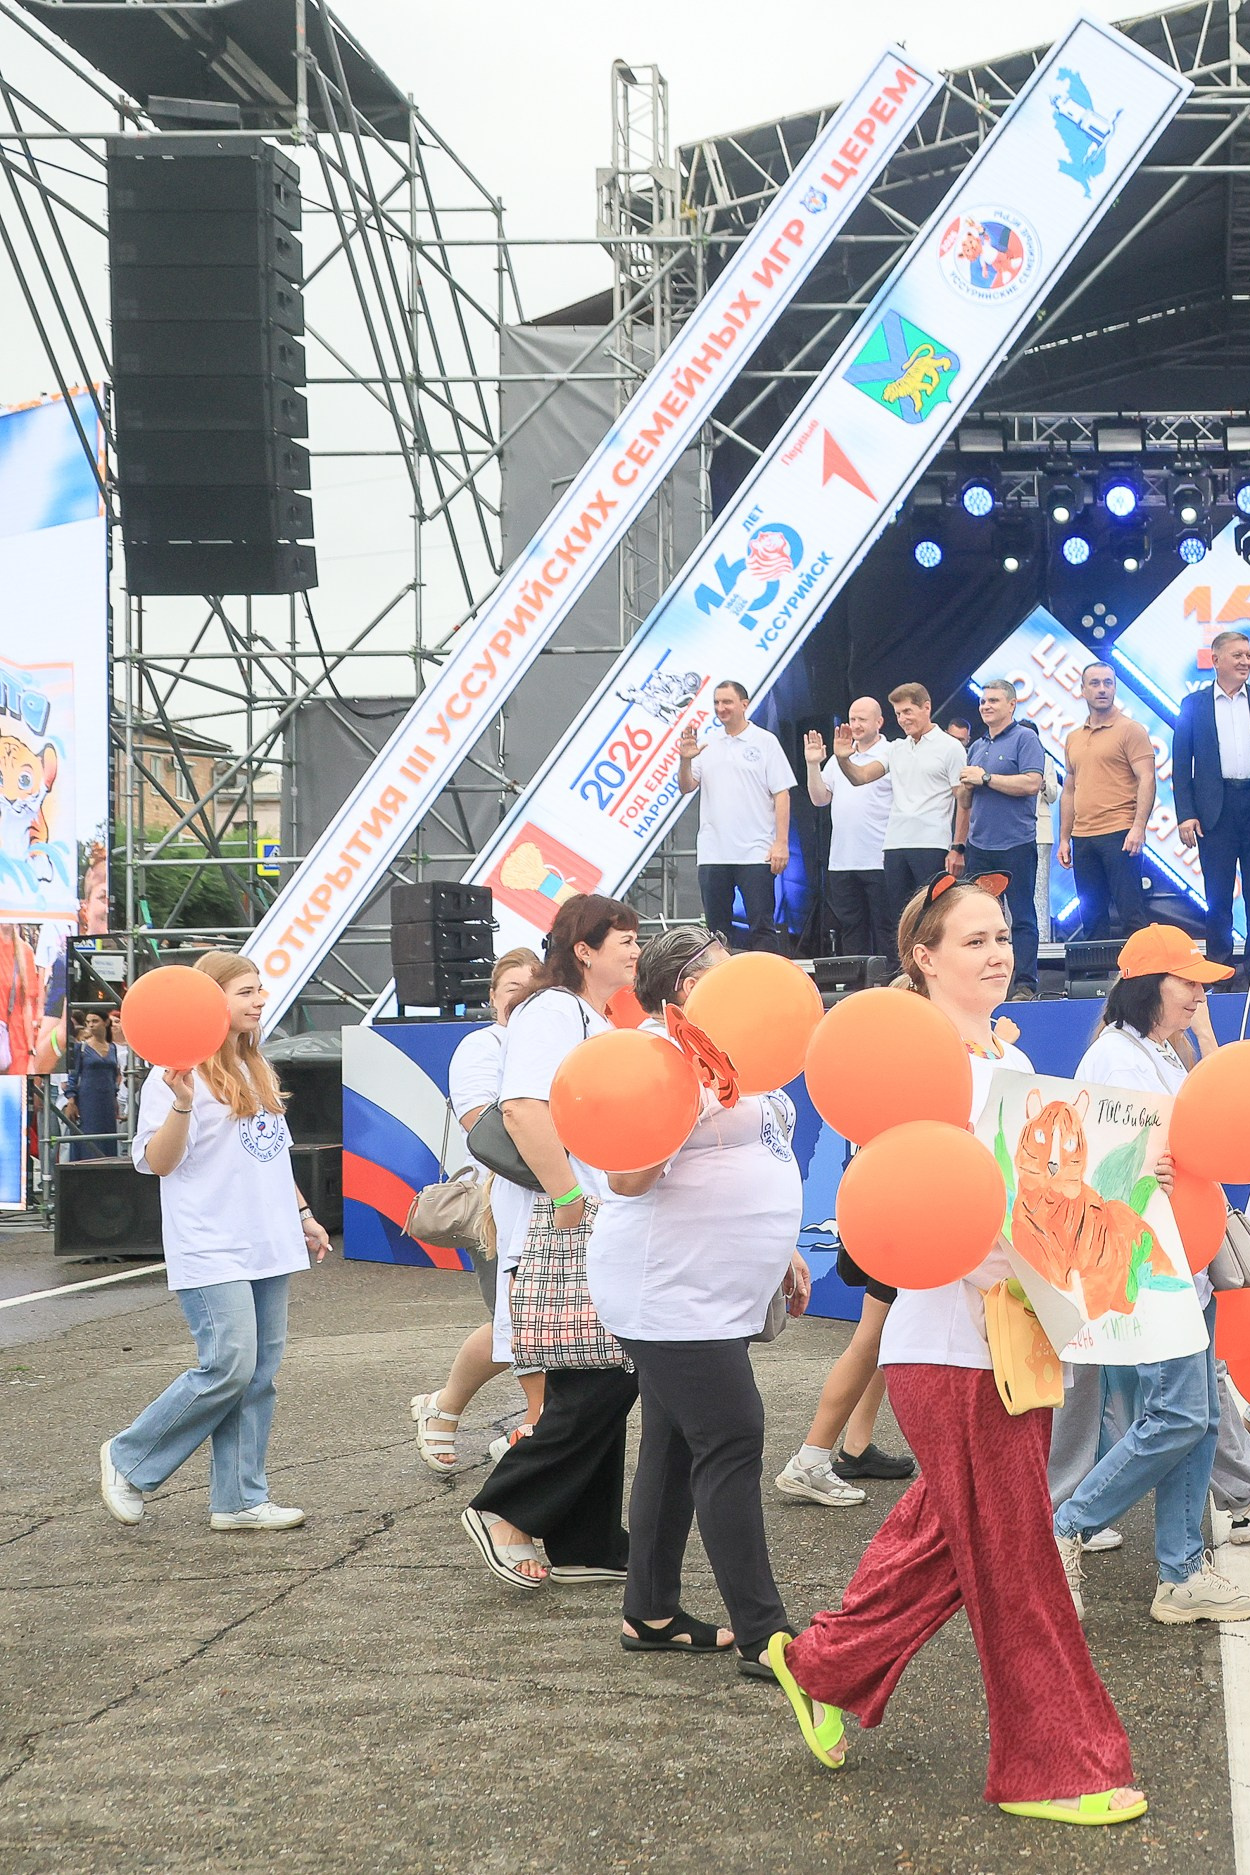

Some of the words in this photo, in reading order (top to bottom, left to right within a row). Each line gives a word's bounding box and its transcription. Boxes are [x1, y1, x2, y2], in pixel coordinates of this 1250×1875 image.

[821, 66, 917, 191] ЦЕРЕМ
[742, 504, 764, 532] ЛЕТ
[264, 784, 408, 978] ОТКРЫТИЯ
[399, 744, 437, 784] III
[426, 489, 618, 744] УССУРИЙСКИХ
[612, 289, 761, 487] СЕМЕЙНЫХ
[752, 219, 806, 289] ИГР
[755, 551, 833, 651] УССУРИЙСК
[580, 723, 653, 811] 2026
[618, 793, 650, 828] ГОД
[645, 708, 709, 792] ЕДИНСВА
